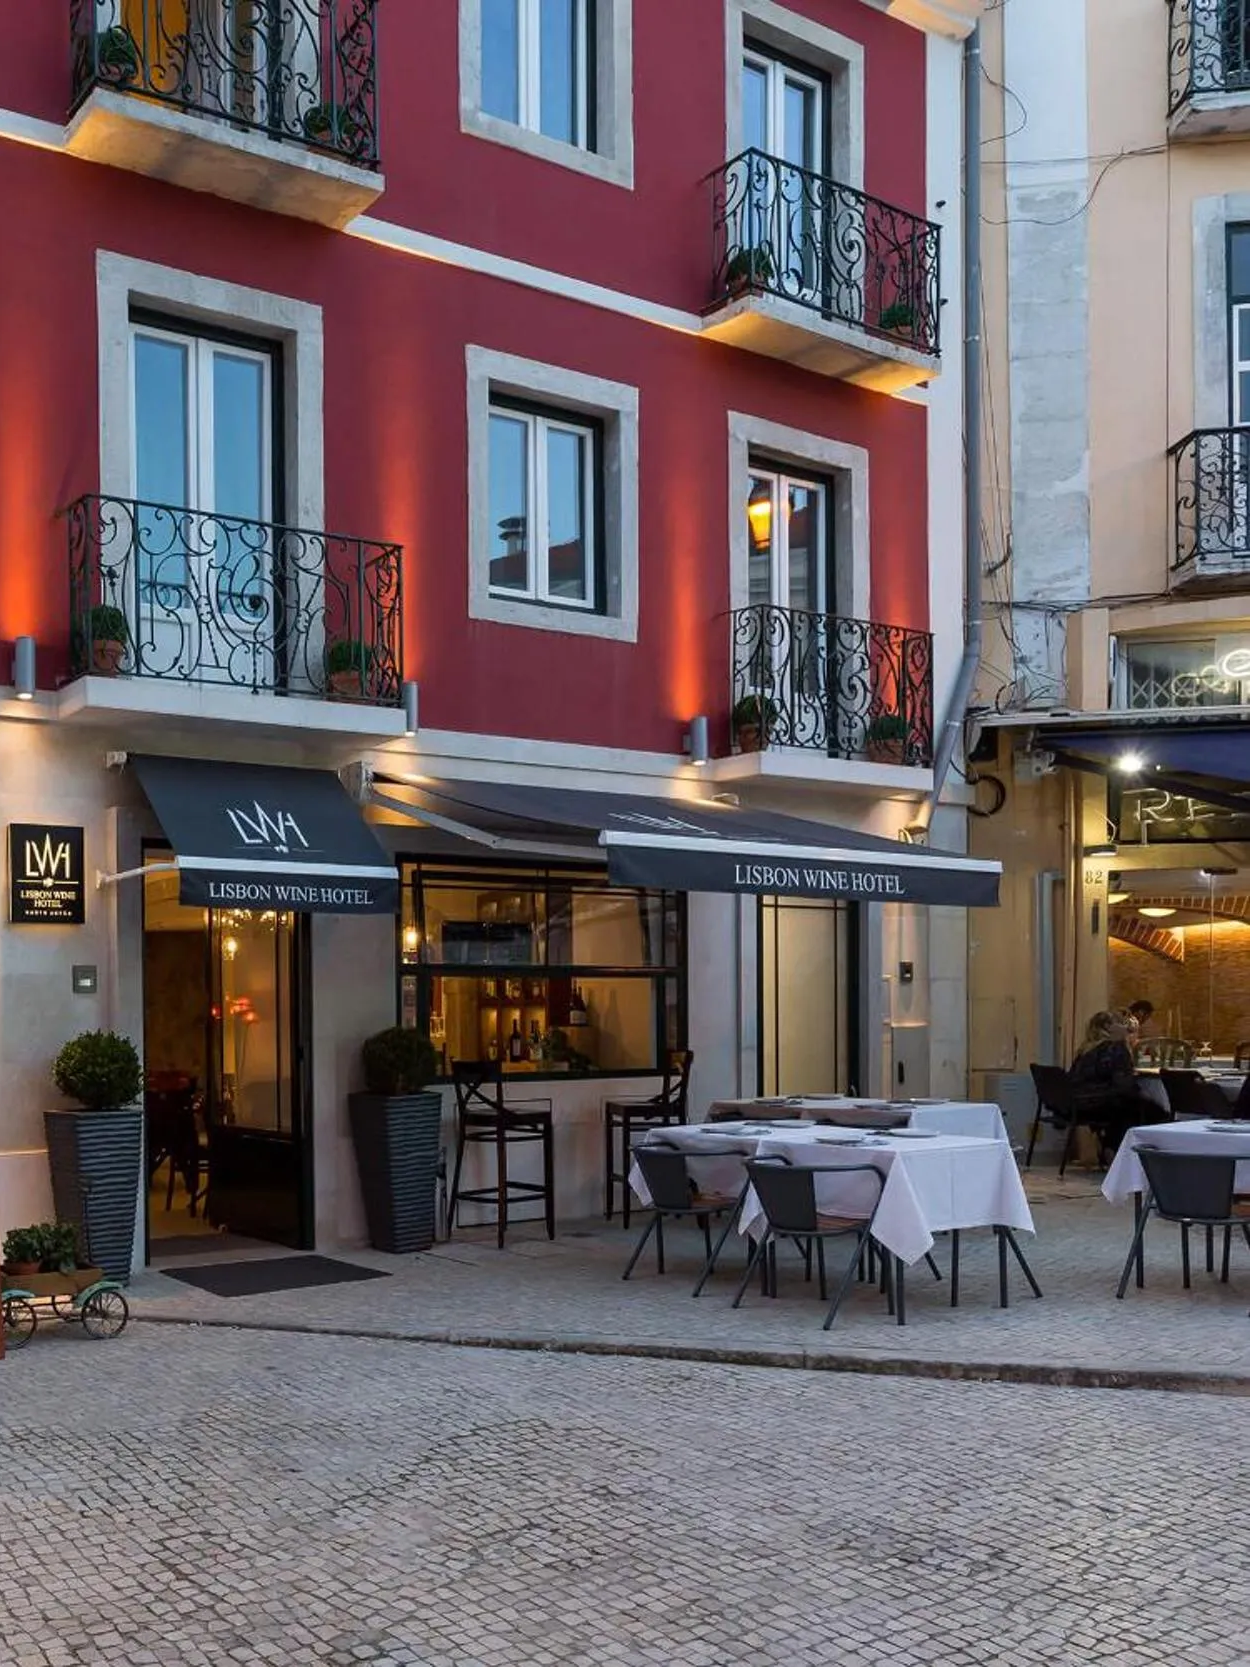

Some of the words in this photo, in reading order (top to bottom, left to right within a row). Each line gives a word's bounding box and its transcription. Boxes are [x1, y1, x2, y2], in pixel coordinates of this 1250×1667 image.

[733, 863, 800, 888] LISBON
[802, 867, 849, 891] WINE
[851, 872, 906, 895] HOTEL
[1084, 870, 1103, 885] 82
[20, 889, 53, 900] LISBON
[53, 890, 77, 901] WINE
[208, 881, 273, 902] LISBON
[274, 884, 319, 904] WINE
[321, 886, 374, 906] HOTEL
[33, 898, 63, 908] HOTEL
